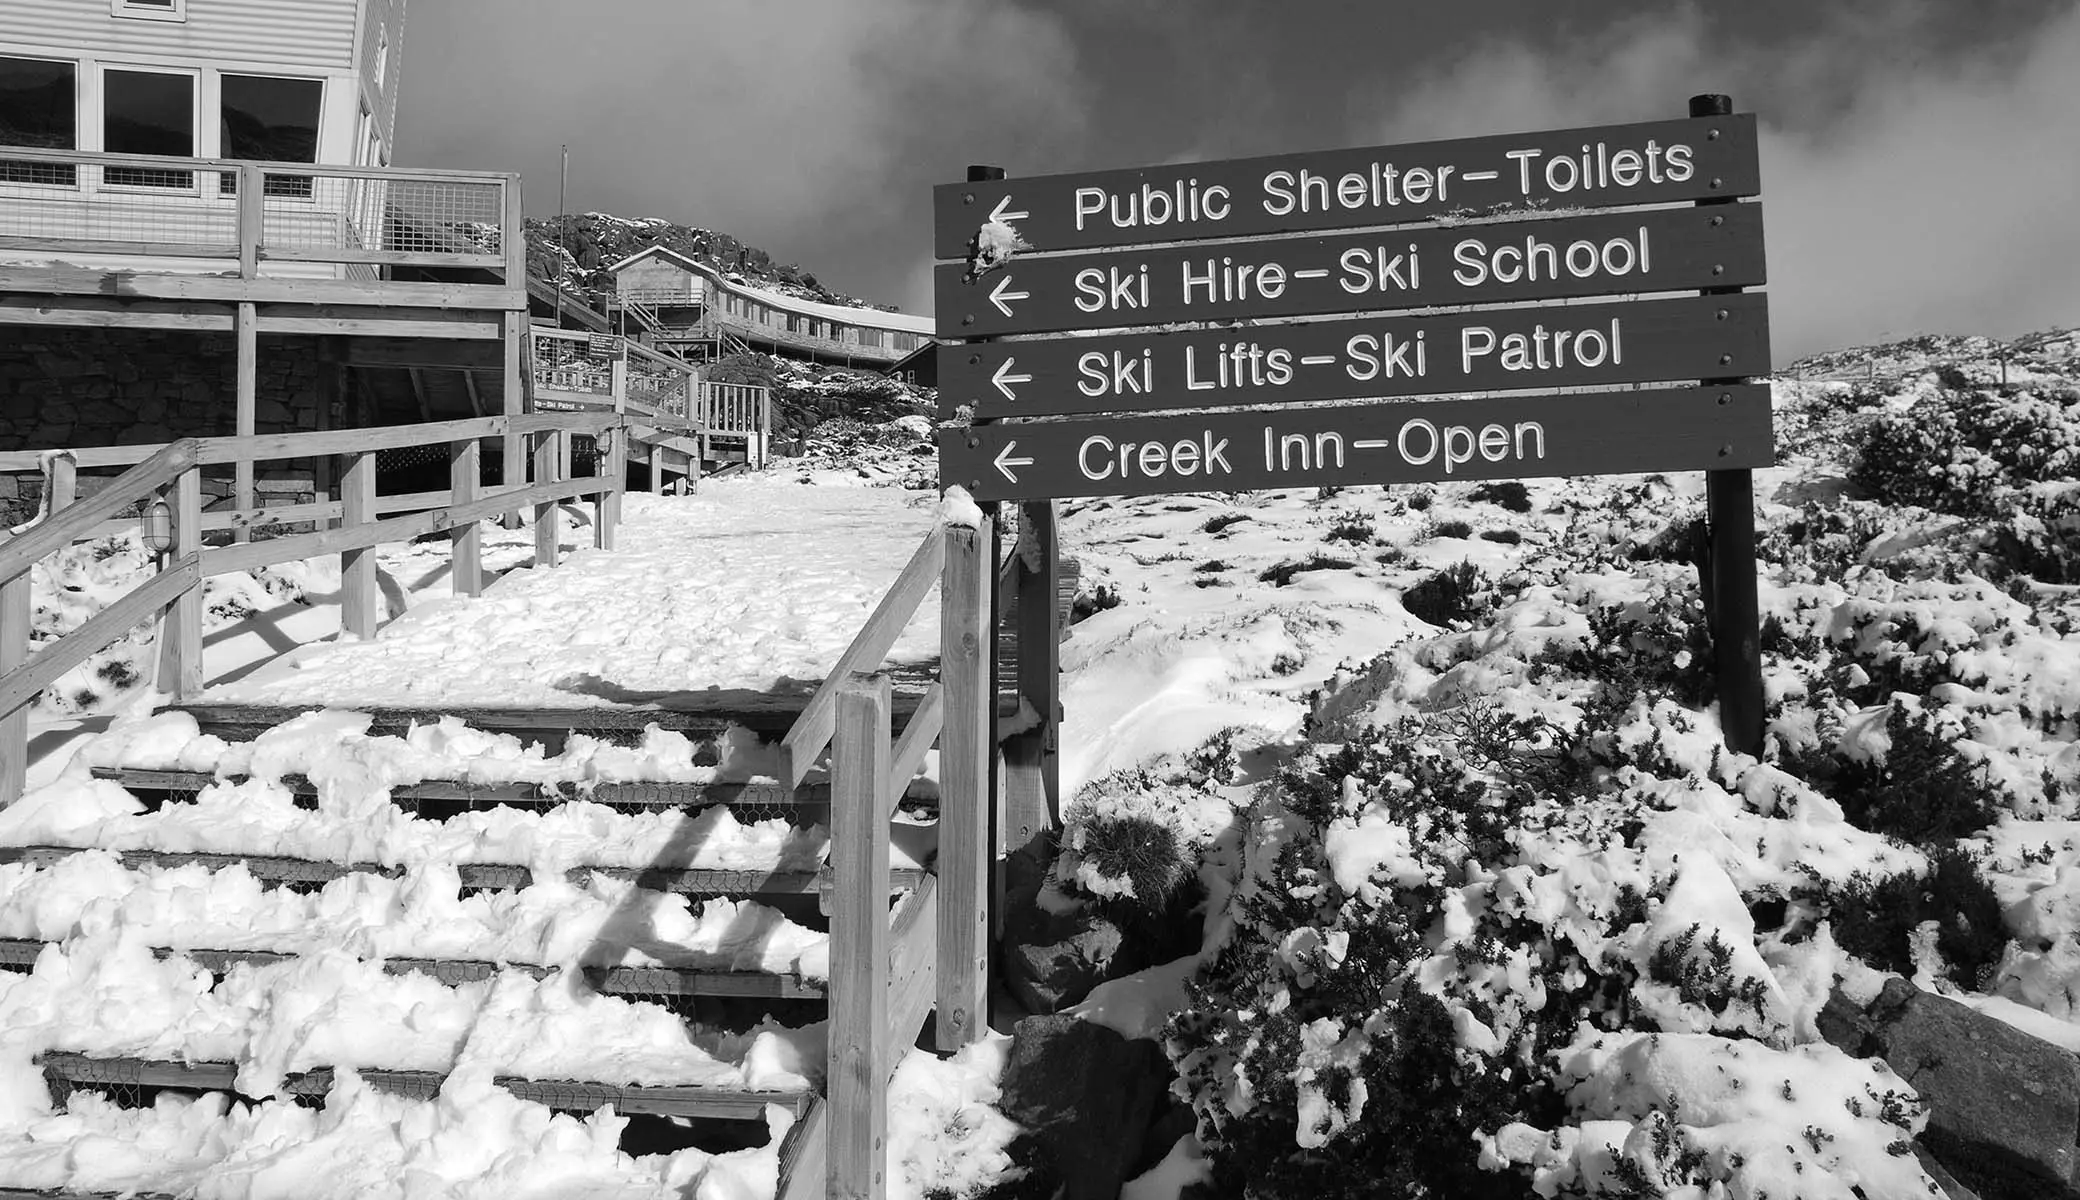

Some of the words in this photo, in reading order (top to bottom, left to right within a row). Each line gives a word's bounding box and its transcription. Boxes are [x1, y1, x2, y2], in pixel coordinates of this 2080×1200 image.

[1075, 178, 1231, 231] Public
[1074, 263, 1150, 313] Ski
[1452, 226, 1650, 287] School
[1077, 348, 1153, 397] Ski
[1461, 317, 1622, 374] Patrol
[1078, 429, 1233, 481] Creek
